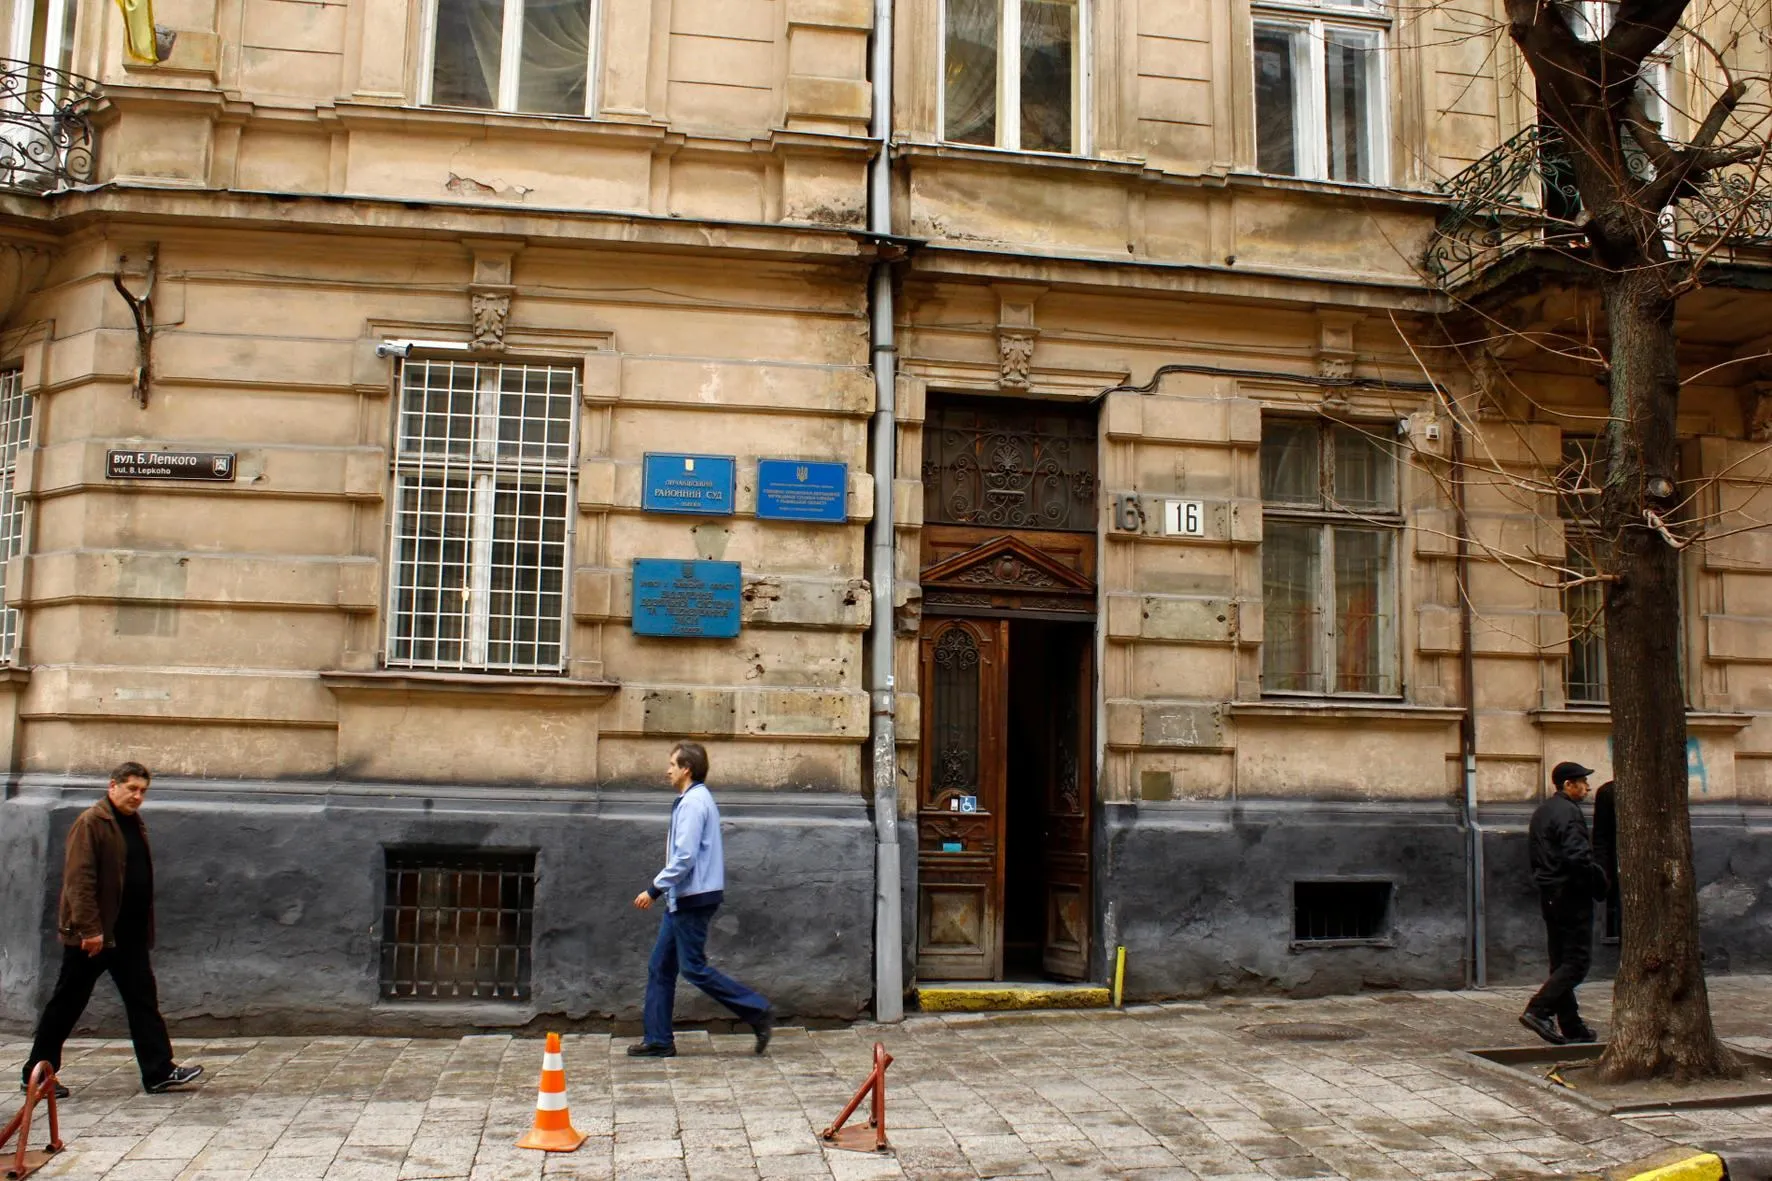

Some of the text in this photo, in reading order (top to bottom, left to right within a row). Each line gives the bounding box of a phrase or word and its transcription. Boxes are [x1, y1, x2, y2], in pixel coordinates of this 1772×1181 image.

[137, 453, 147, 464] Б.
[148, 453, 197, 466] Лепкого
[138, 467, 171, 475] Lepkoho
[654, 488, 723, 500] РАЙОННИЙ СУД
[1176, 503, 1198, 532] 16
